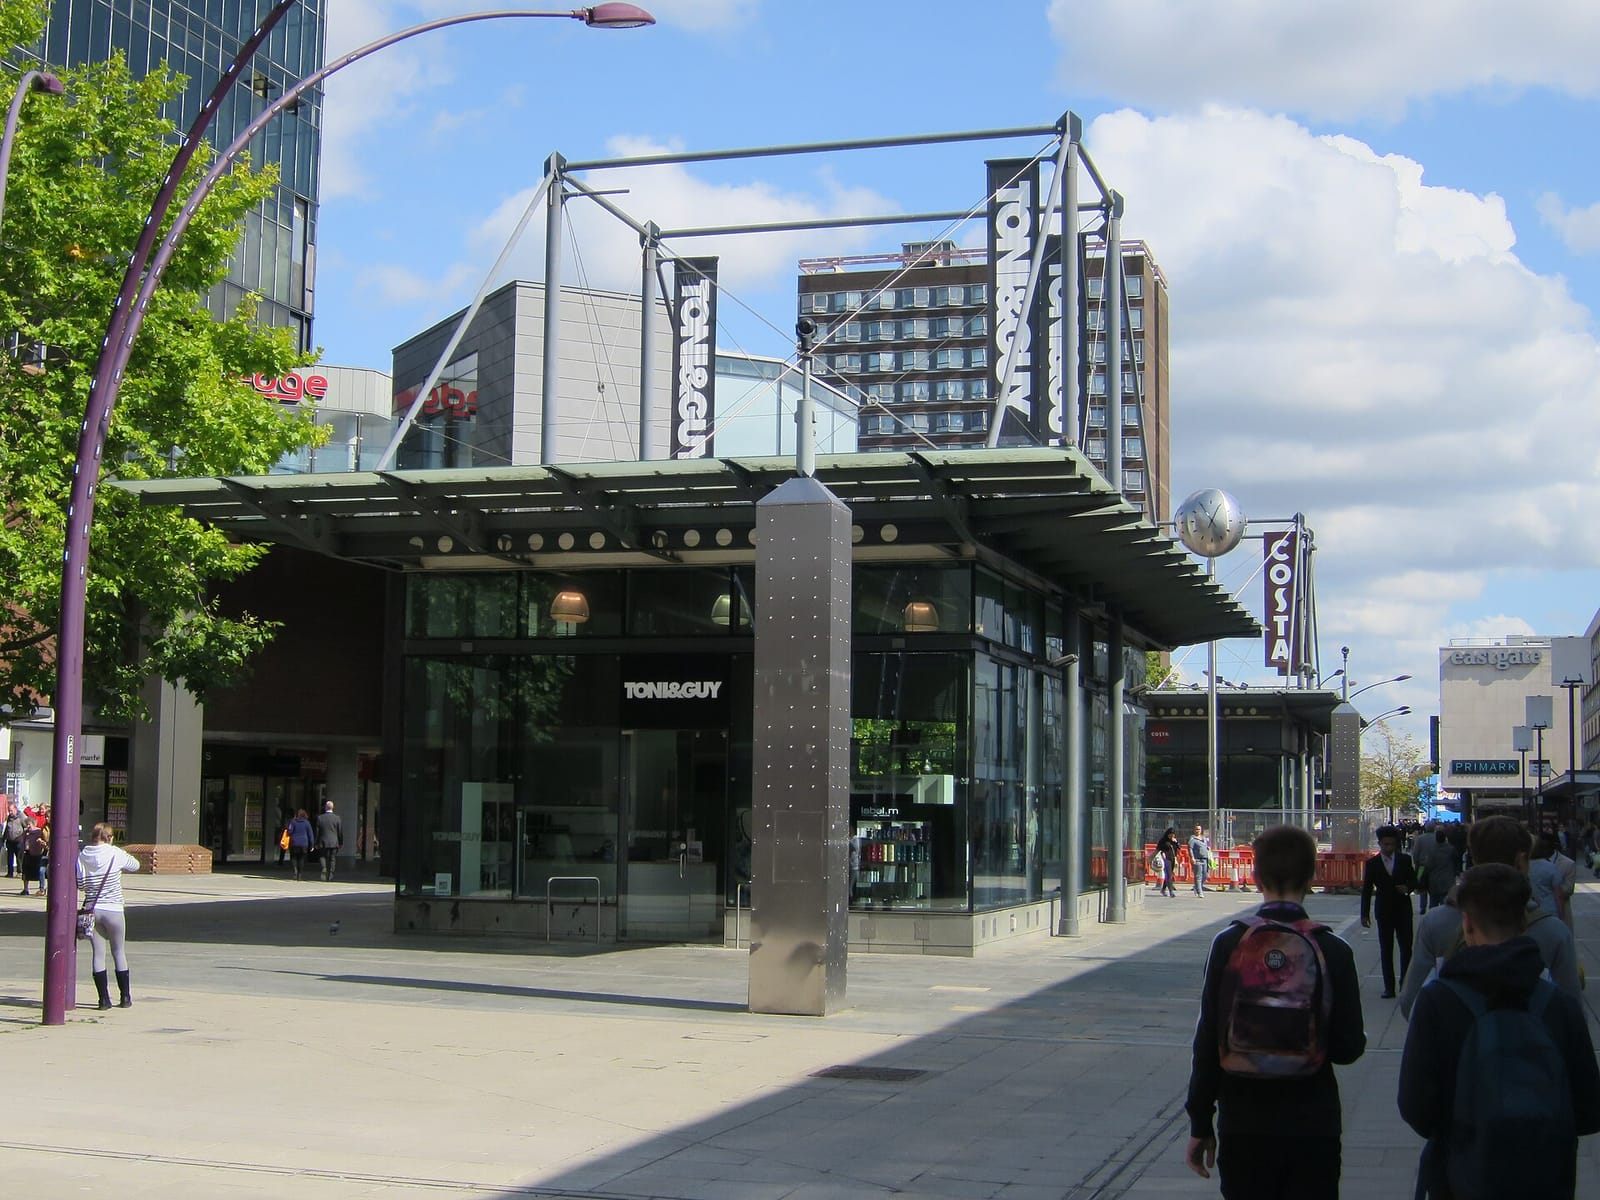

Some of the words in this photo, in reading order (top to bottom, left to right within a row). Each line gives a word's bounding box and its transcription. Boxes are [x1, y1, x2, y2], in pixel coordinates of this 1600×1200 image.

[1269, 539, 1292, 661] COSTA
[1450, 650, 1542, 671] eastgate
[624, 681, 722, 699] TONI&GUY
[1455, 762, 1517, 773] PRIMARK
